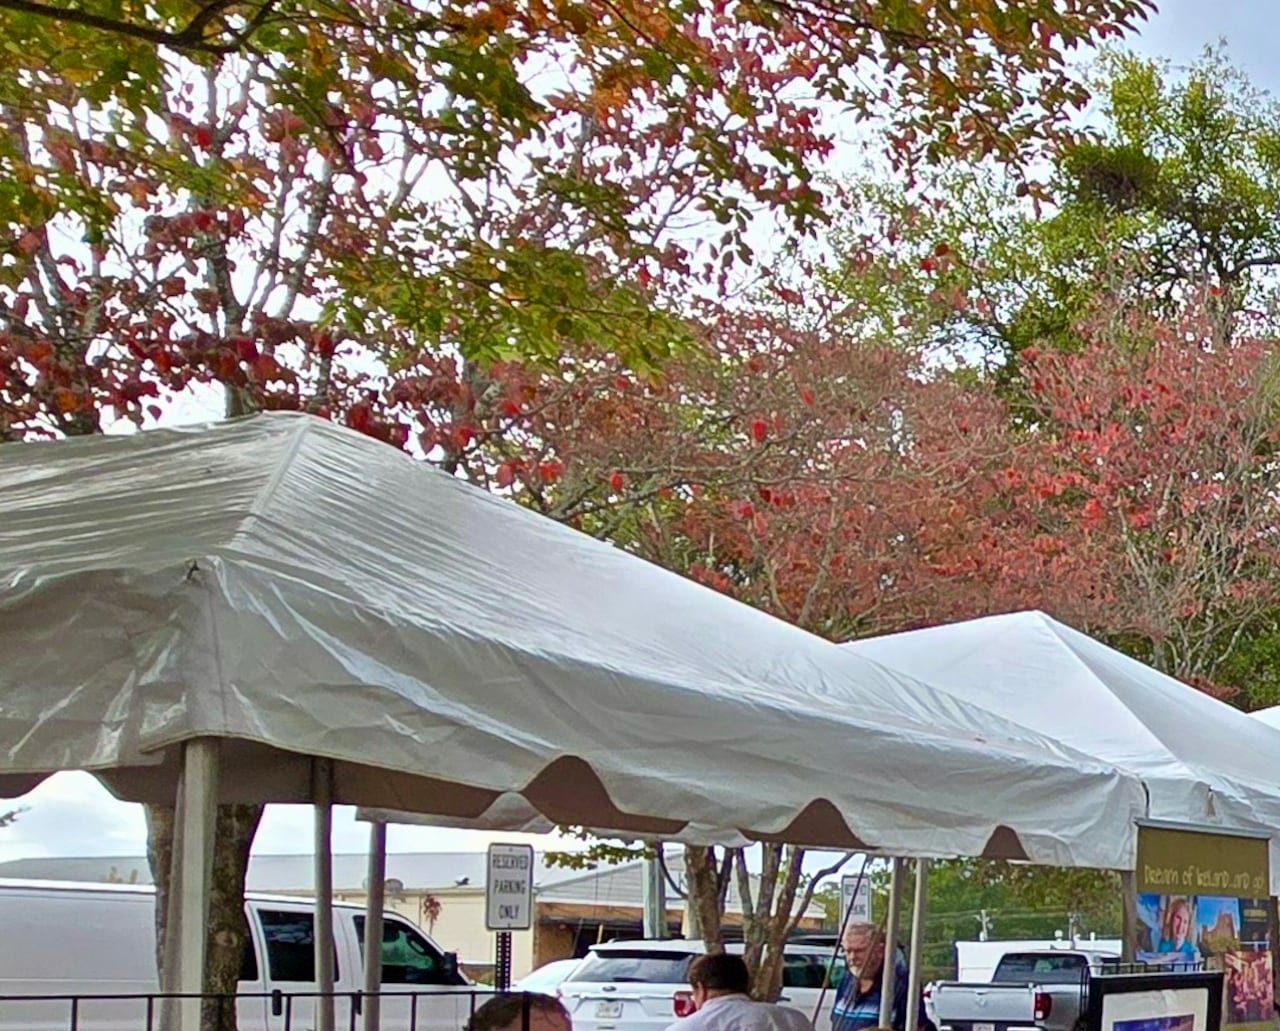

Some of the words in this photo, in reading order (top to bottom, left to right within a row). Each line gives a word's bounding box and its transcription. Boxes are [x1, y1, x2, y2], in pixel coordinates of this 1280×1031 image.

[493, 854, 528, 869] RESERVED
[1182, 864, 1194, 886] of
[494, 879, 526, 894] PARKING
[499, 904, 519, 919] ONLY
